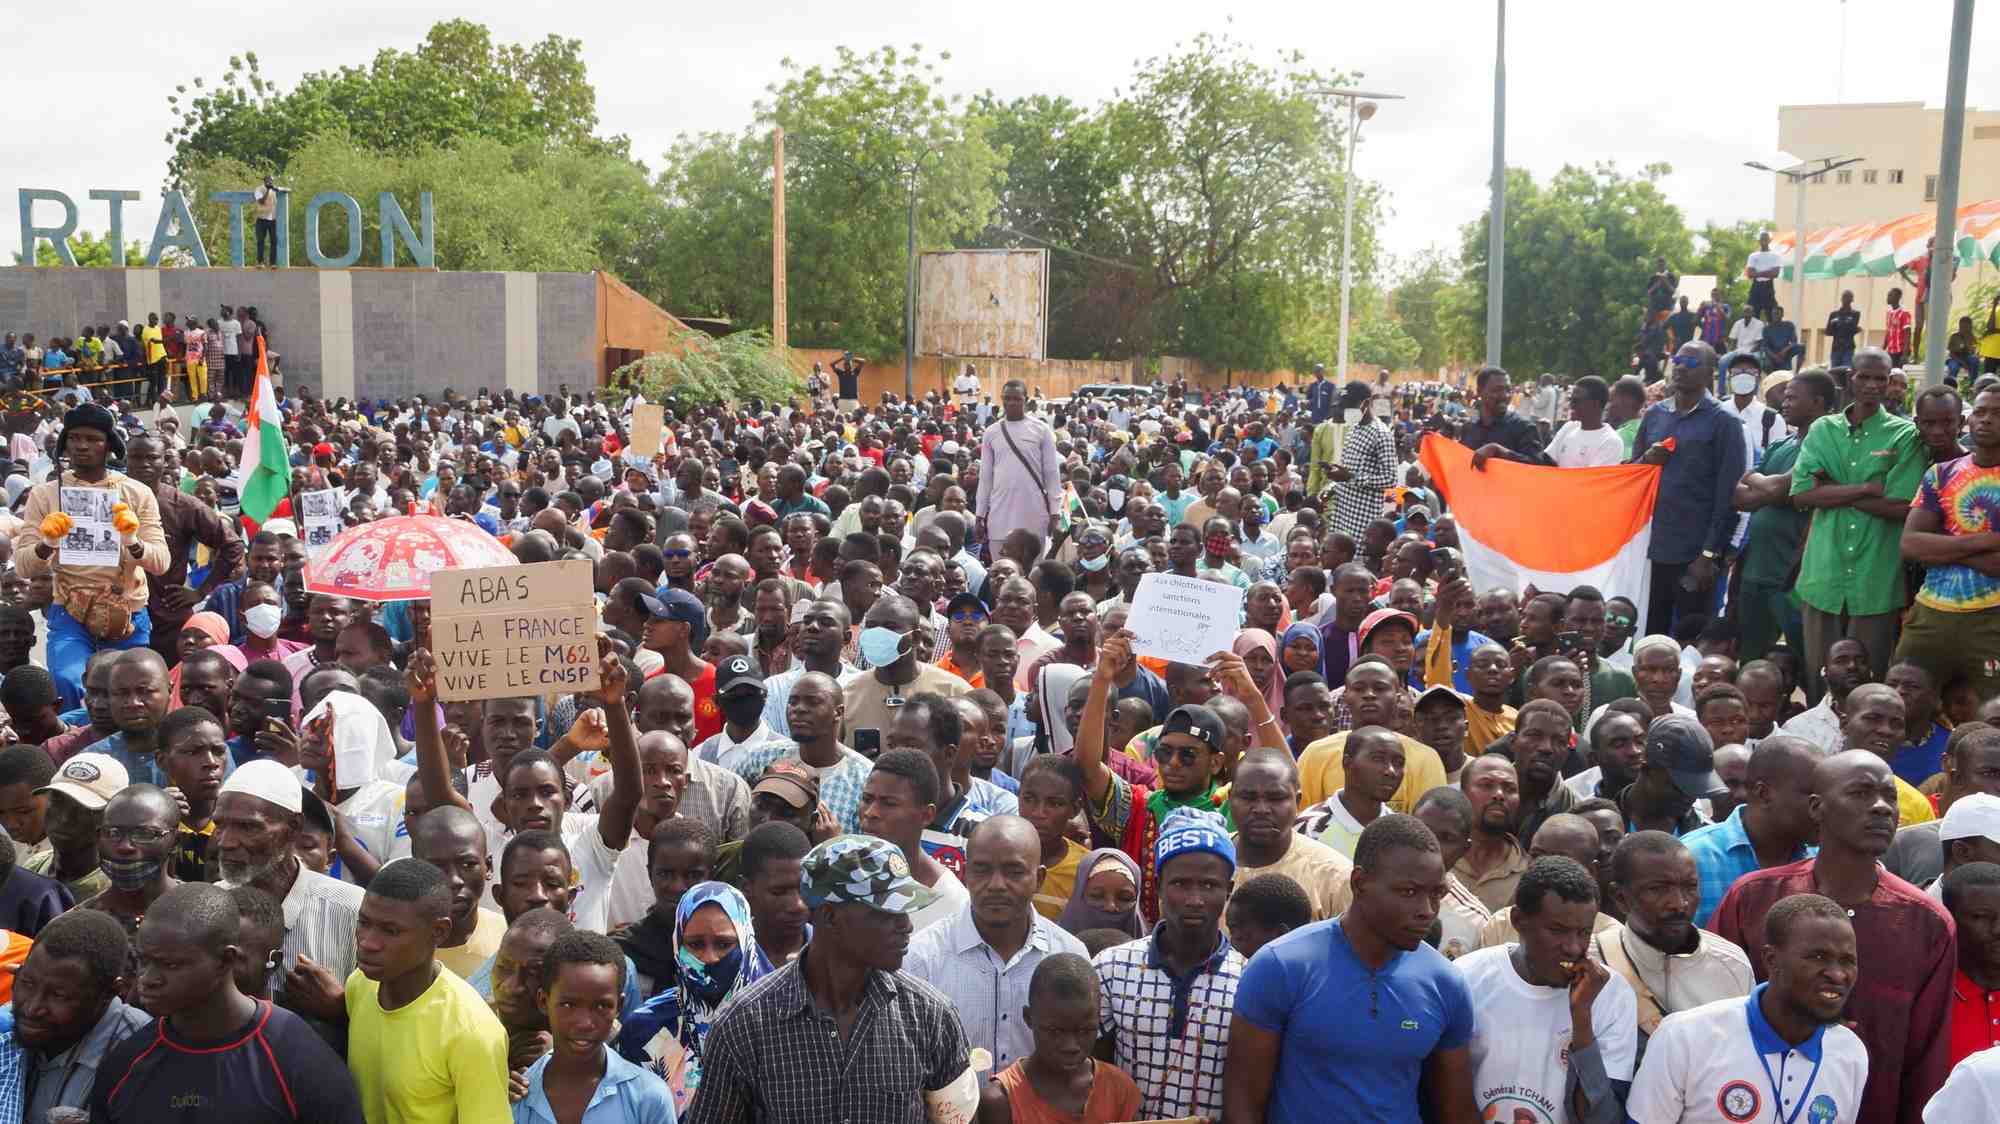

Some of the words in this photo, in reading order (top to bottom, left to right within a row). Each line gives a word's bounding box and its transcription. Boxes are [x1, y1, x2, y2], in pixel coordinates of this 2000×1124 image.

[16, 187, 437, 269] RTATION
[460, 575, 529, 605] ABAS
[455, 619, 484, 643] LA
[504, 616, 585, 641] FRANCE
[441, 648, 492, 668] VIVE
[506, 646, 531, 665] LE
[544, 644, 590, 665] M62
[444, 673, 487, 691] VIVE
[506, 668, 531, 688] LE
[539, 666, 590, 685] CNSP
[1158, 829, 1219, 858] BEST
